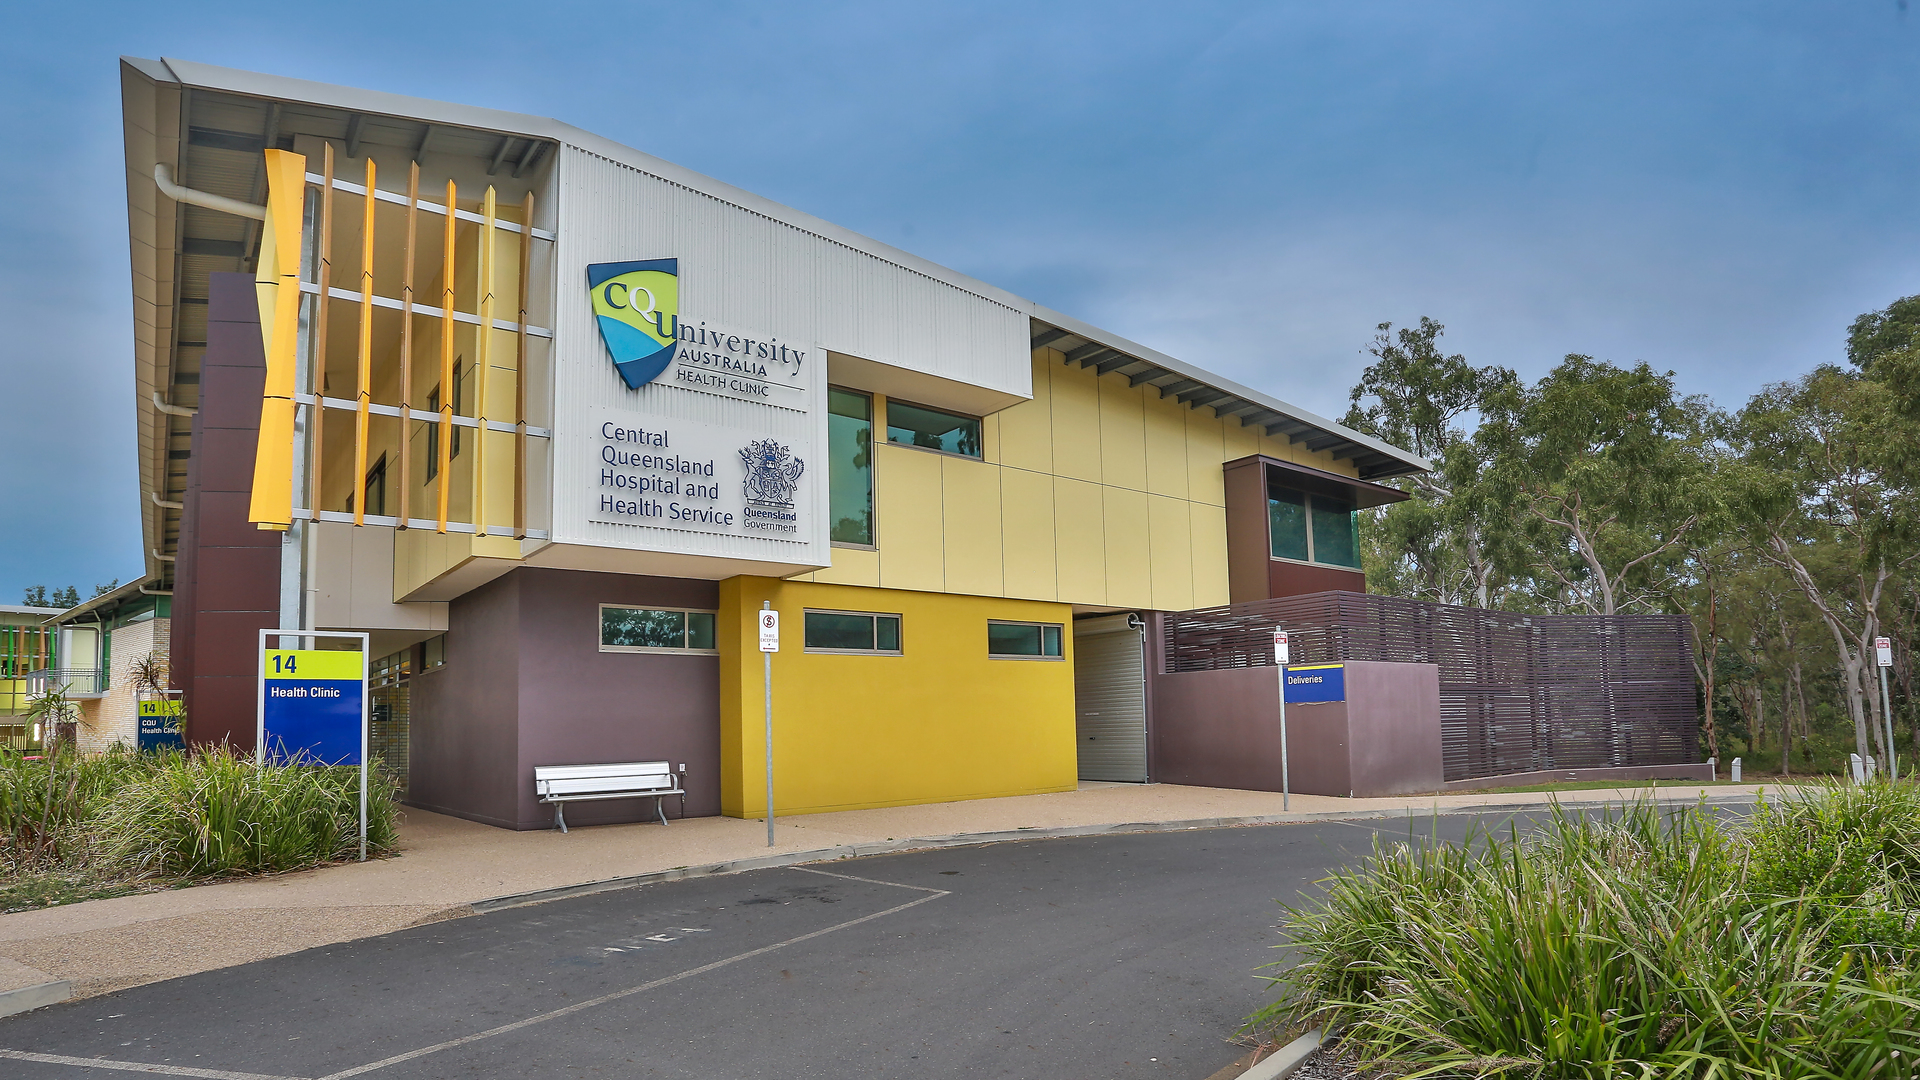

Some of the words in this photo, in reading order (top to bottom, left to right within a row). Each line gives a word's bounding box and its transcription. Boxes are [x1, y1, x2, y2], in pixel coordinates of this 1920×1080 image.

[678, 348, 768, 377] AUSTRALIA
[676, 369, 727, 389] HEALTH
[730, 380, 769, 397] CLINIC
[601, 421, 669, 448] Central
[601, 445, 714, 477] Queensland
[600, 468, 680, 495] Hospital
[685, 482, 719, 500] and
[600, 494, 663, 518] Health
[669, 502, 734, 526] Service
[743, 506, 797, 521] Queensland
[743, 519, 797, 533] Government
[272, 655, 297, 673] 14
[1288, 674, 1323, 684] Deliveries
[271, 687, 307, 698] Health
[310, 687, 340, 698] Clinic
[142, 703, 156, 714] 14
